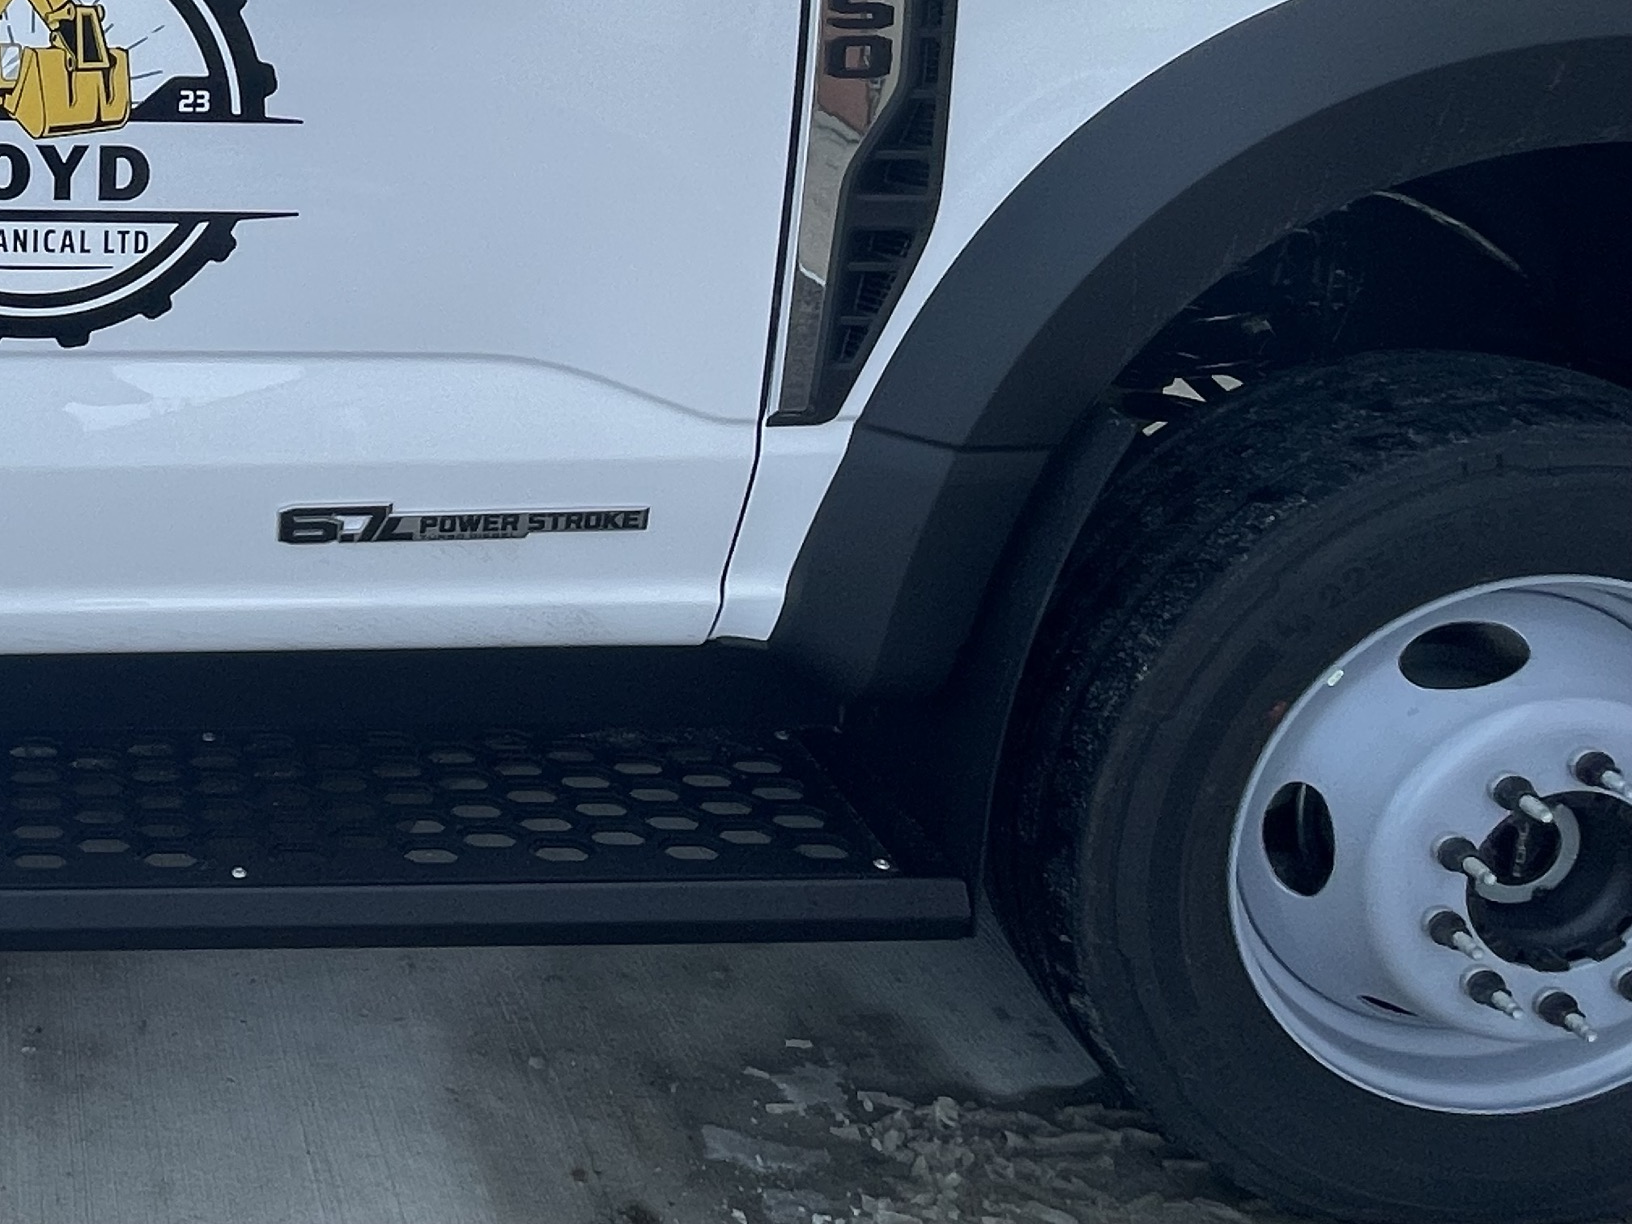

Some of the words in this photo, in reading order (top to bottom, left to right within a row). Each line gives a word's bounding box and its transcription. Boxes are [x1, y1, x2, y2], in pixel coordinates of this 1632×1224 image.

[178, 89, 211, 113] 23
[103, 230, 150, 255] LTD
[277, 506, 414, 544] 6.7L
[419, 514, 521, 534] POWER
[527, 510, 642, 531] STROKE
